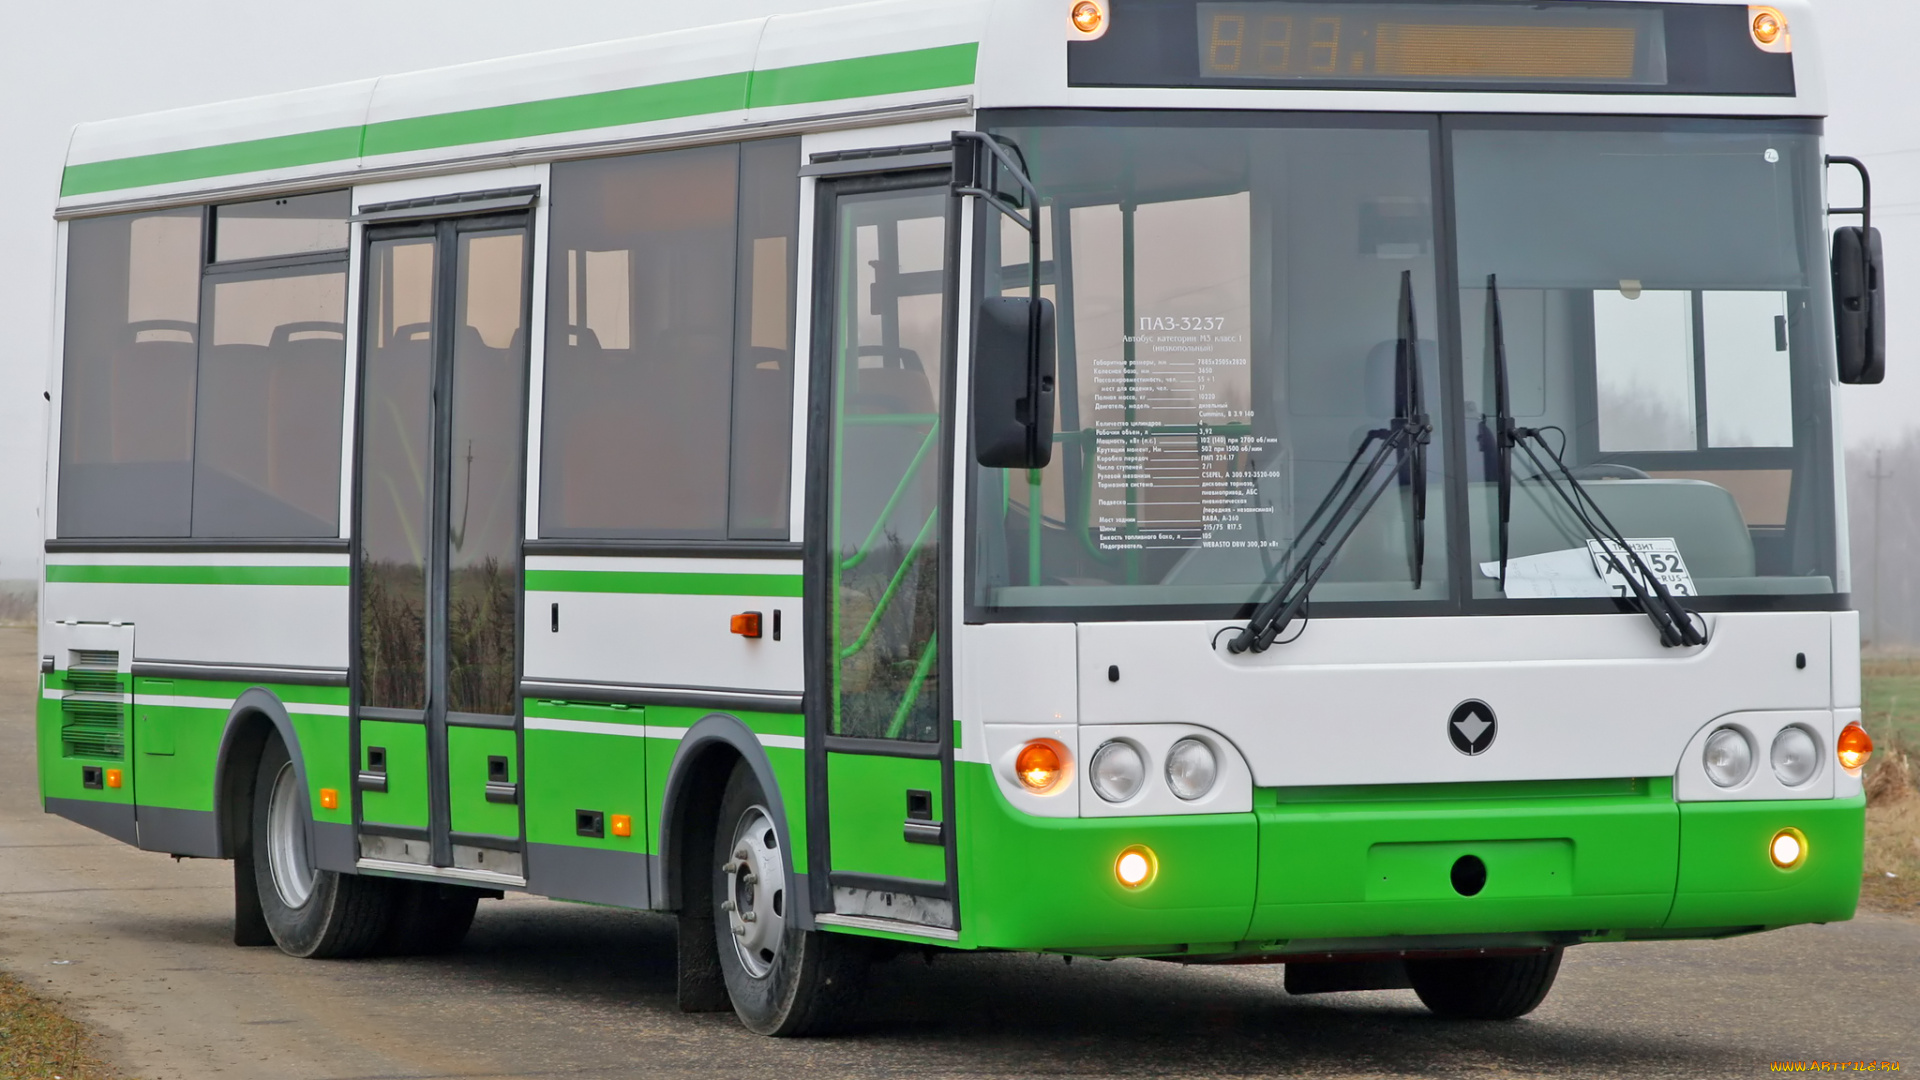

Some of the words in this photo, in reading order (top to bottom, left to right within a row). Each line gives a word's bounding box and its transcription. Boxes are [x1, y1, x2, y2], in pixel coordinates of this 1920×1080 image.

[1140, 316, 1224, 331] ПАЗ-3237
[1123, 335, 1153, 344] Автобус
[1157, 336, 1197, 344] категории
[1153, 345, 1213, 353] (низкопольный)
[1095, 403, 1127, 411] Двигатель,
[1650, 554, 1684, 573] 52
[1661, 575, 1683, 583] RUS
